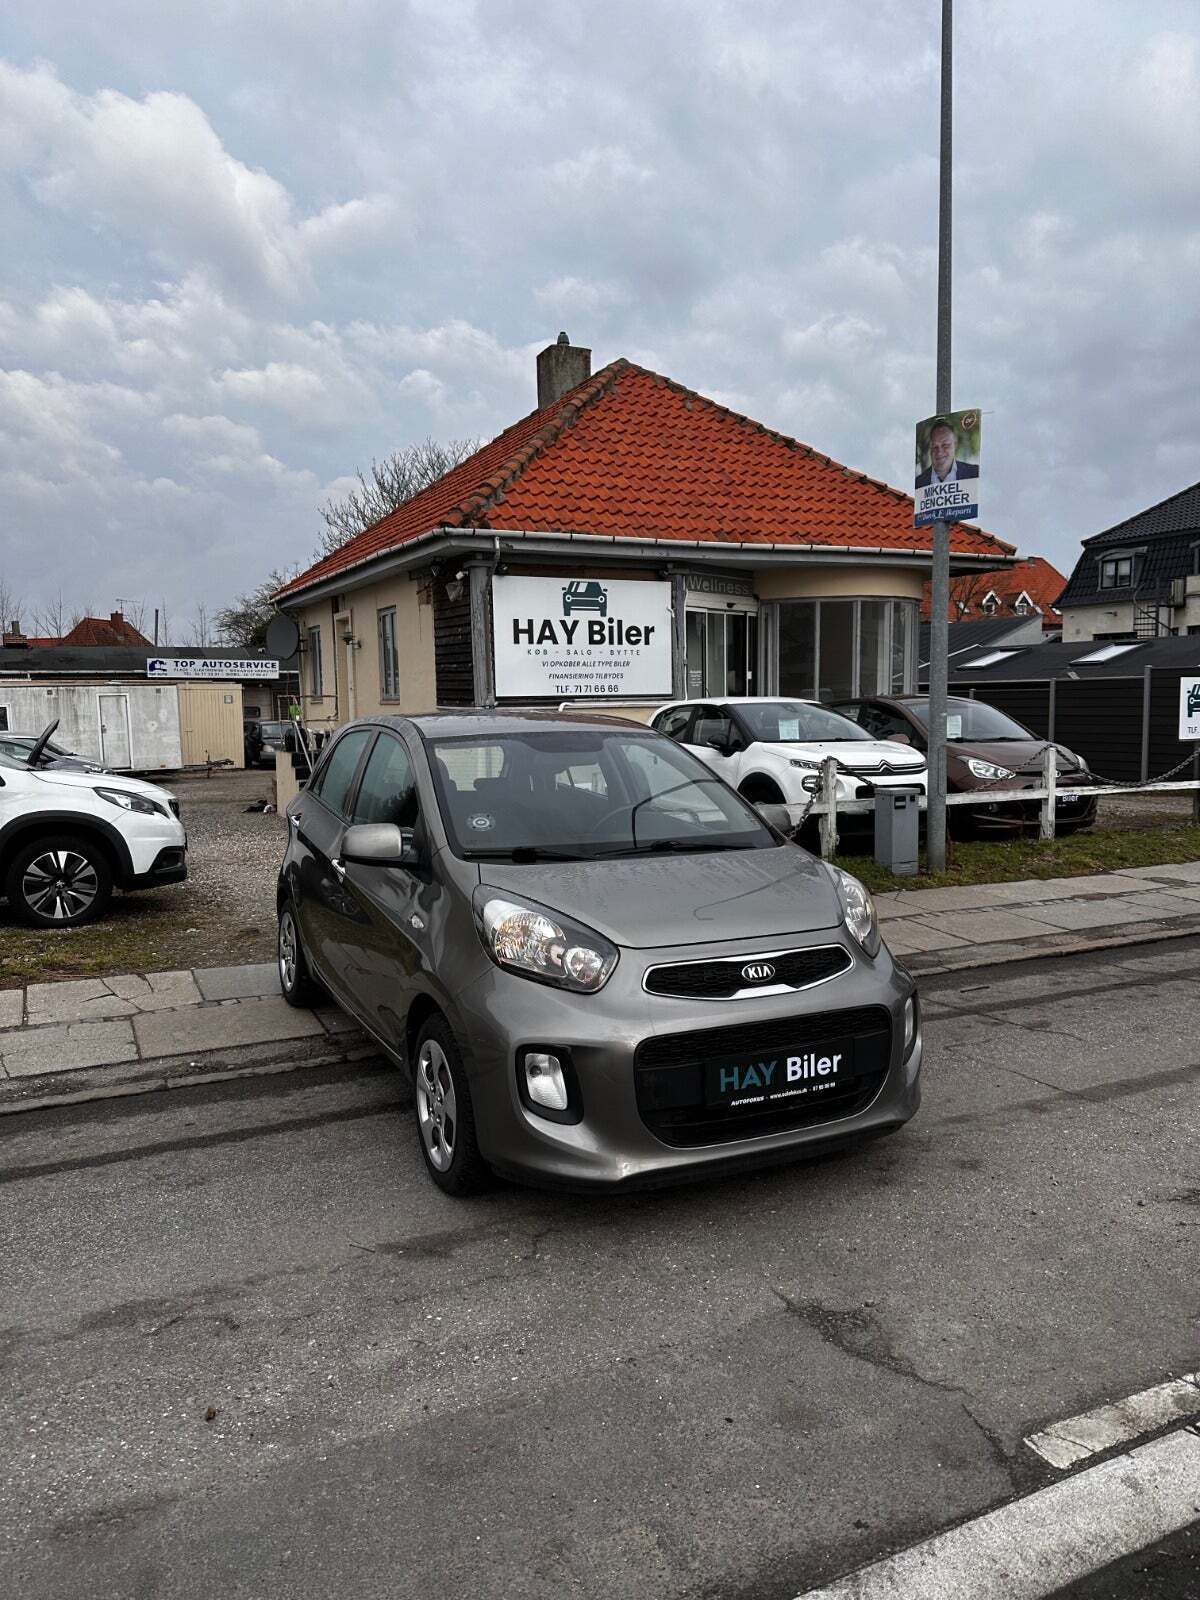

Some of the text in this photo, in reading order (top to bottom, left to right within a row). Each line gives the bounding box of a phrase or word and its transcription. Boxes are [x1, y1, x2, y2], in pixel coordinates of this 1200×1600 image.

[924, 482, 963, 498] MIKKEL
[920, 493, 970, 511] DENCKER
[686, 575, 749, 595] Wellness
[513, 617, 655, 645] HAY Biler
[527, 648, 548, 656] KØB
[173, 660, 277, 669] TOP AUTOSERVICE
[548, 672, 624, 680] FINANSIERING TILBYDES
[555, 684, 619, 693] TLF. 71 71 66 66
[748, 964, 772, 979] KIA
[719, 1053, 842, 1093] HAY Biler
